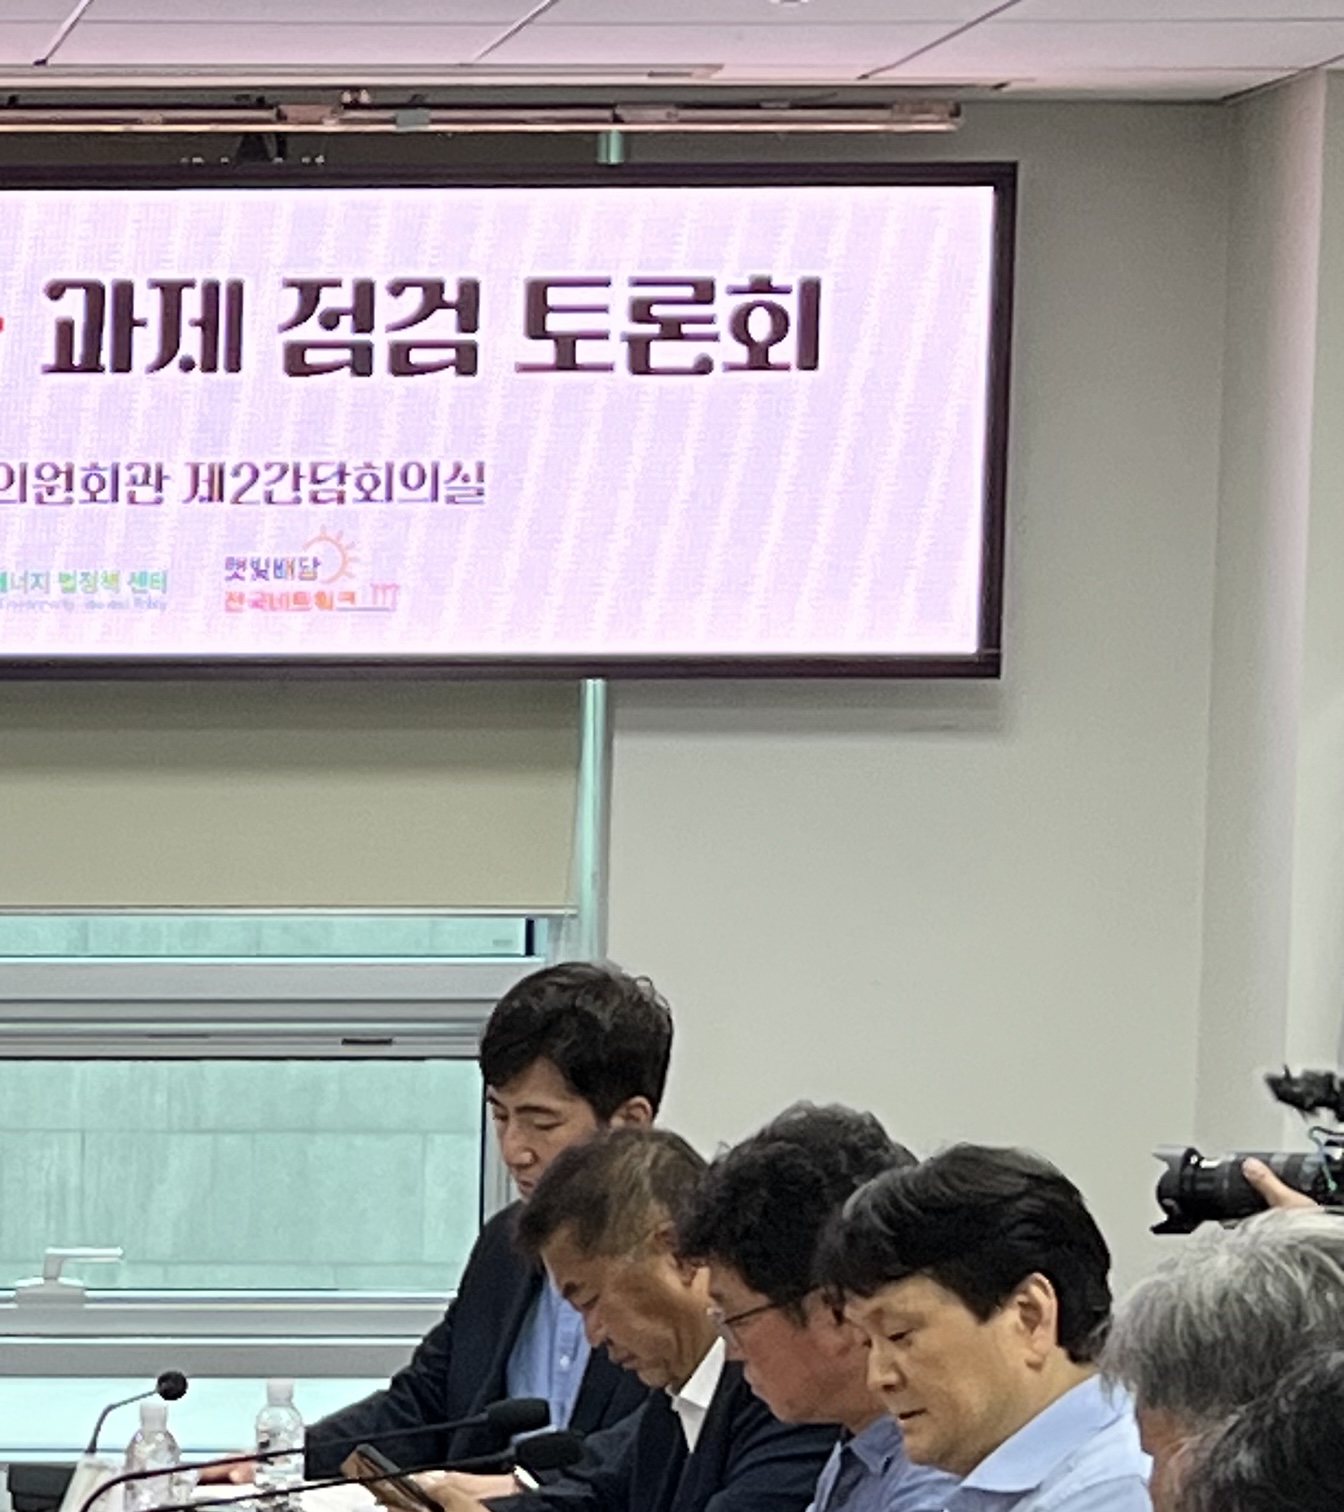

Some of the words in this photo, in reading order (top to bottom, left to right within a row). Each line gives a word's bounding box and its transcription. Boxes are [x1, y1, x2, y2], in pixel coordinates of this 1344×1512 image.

[42, 279, 244, 375] 과제
[278, 278, 481, 378] 점검
[515, 276, 822, 376] 토론회
[183, 461, 485, 506] 제2간담회의실
[127, 570, 168, 594] 센터
